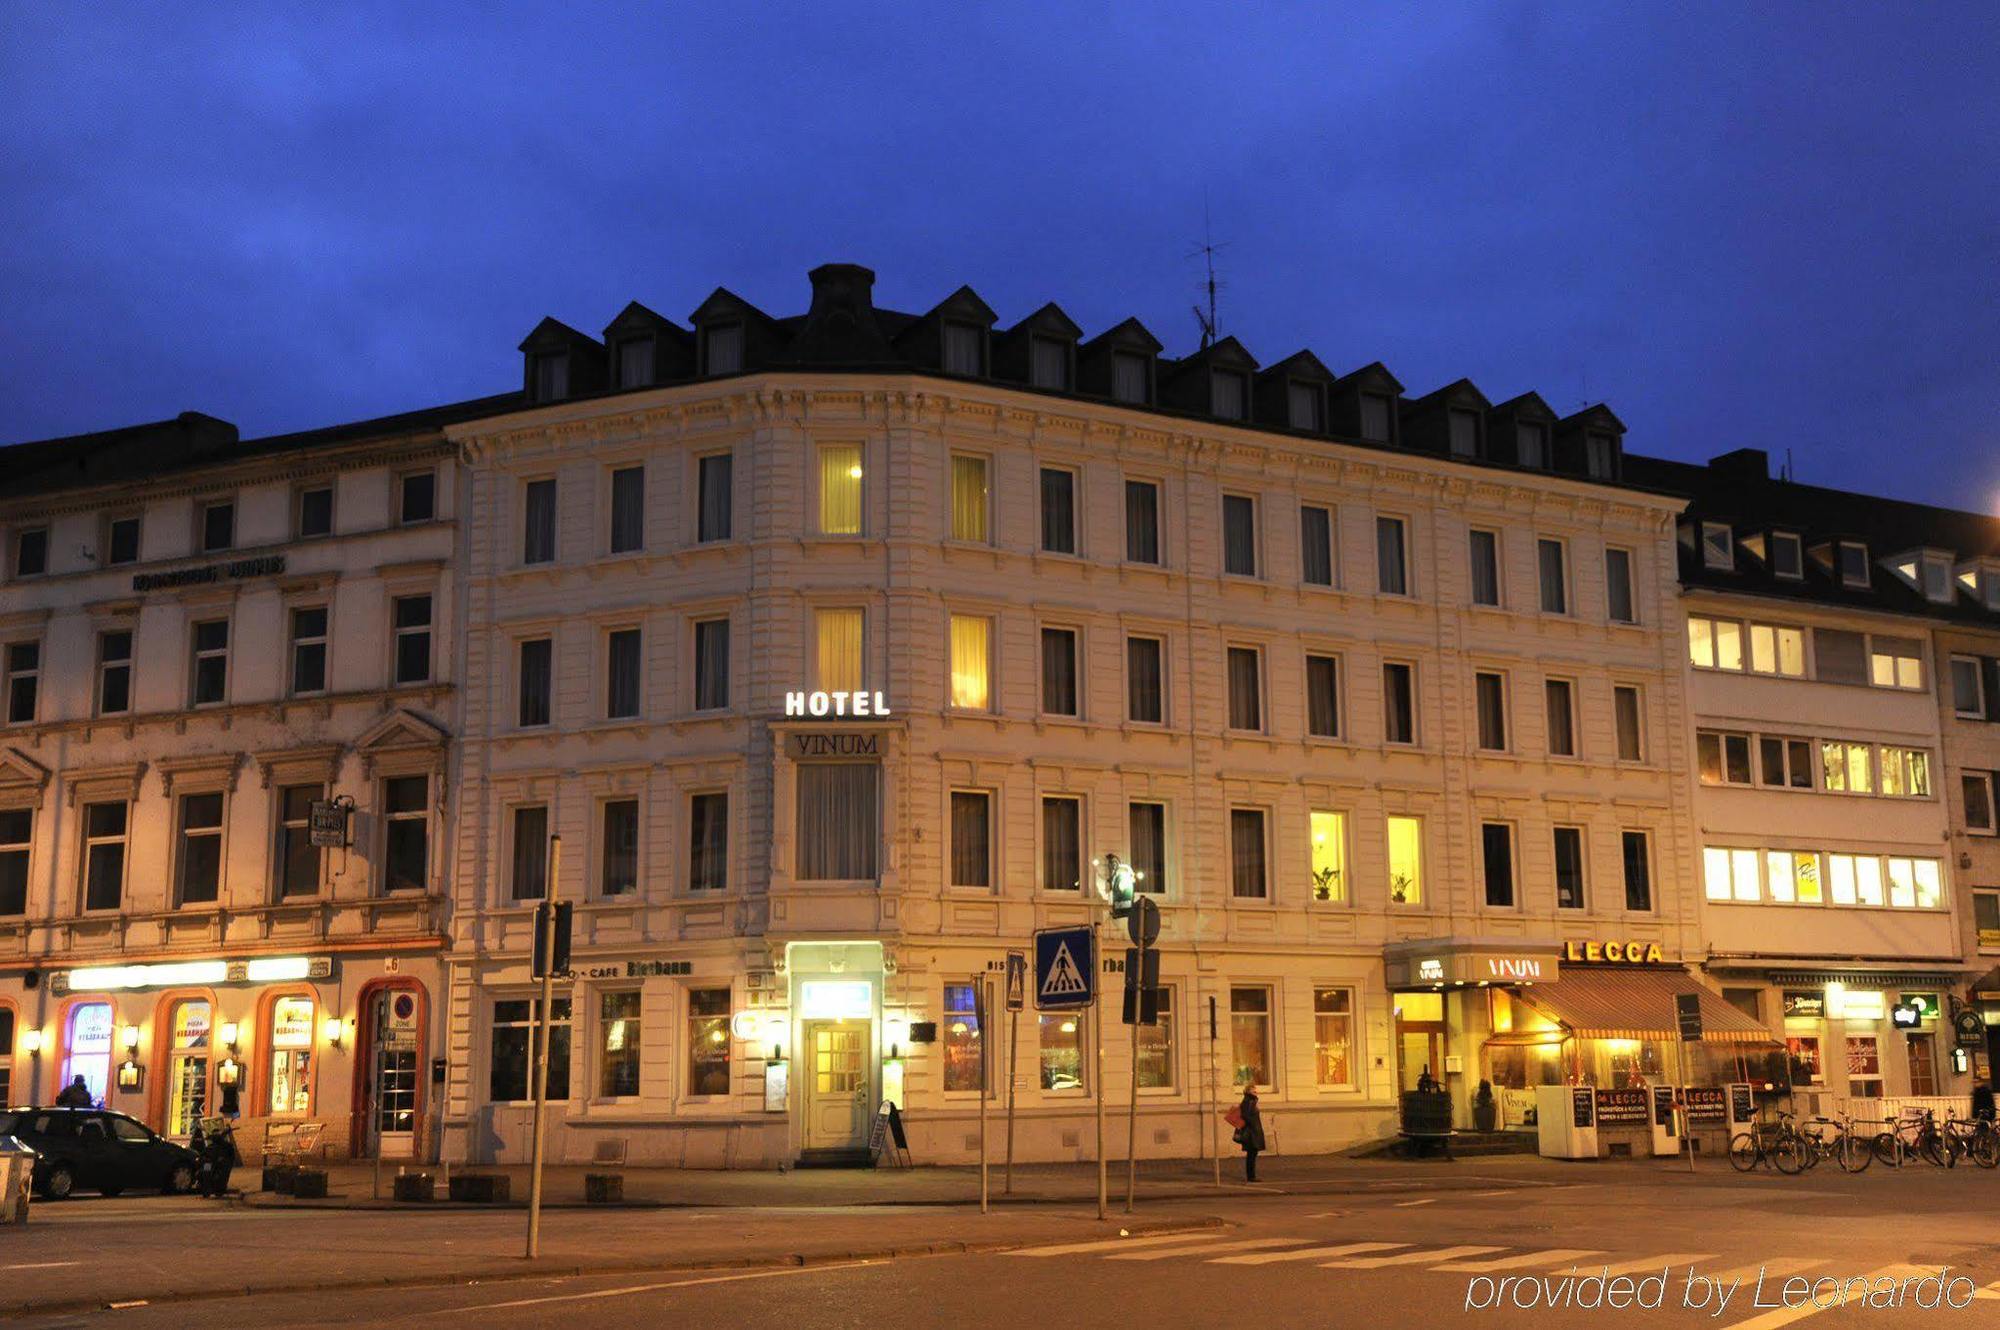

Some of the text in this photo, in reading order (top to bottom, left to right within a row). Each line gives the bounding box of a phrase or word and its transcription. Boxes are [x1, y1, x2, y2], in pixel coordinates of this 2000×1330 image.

[785, 691, 891, 716] HOTEL
[795, 734, 879, 754] VINUM
[1565, 940, 1663, 963] LECCA
[590, 967, 618, 977] CAFE
[1489, 958, 1540, 977] VINUM
[1610, 1094, 1645, 1104] LECCA
[1689, 1092, 1723, 1102] LECCA
